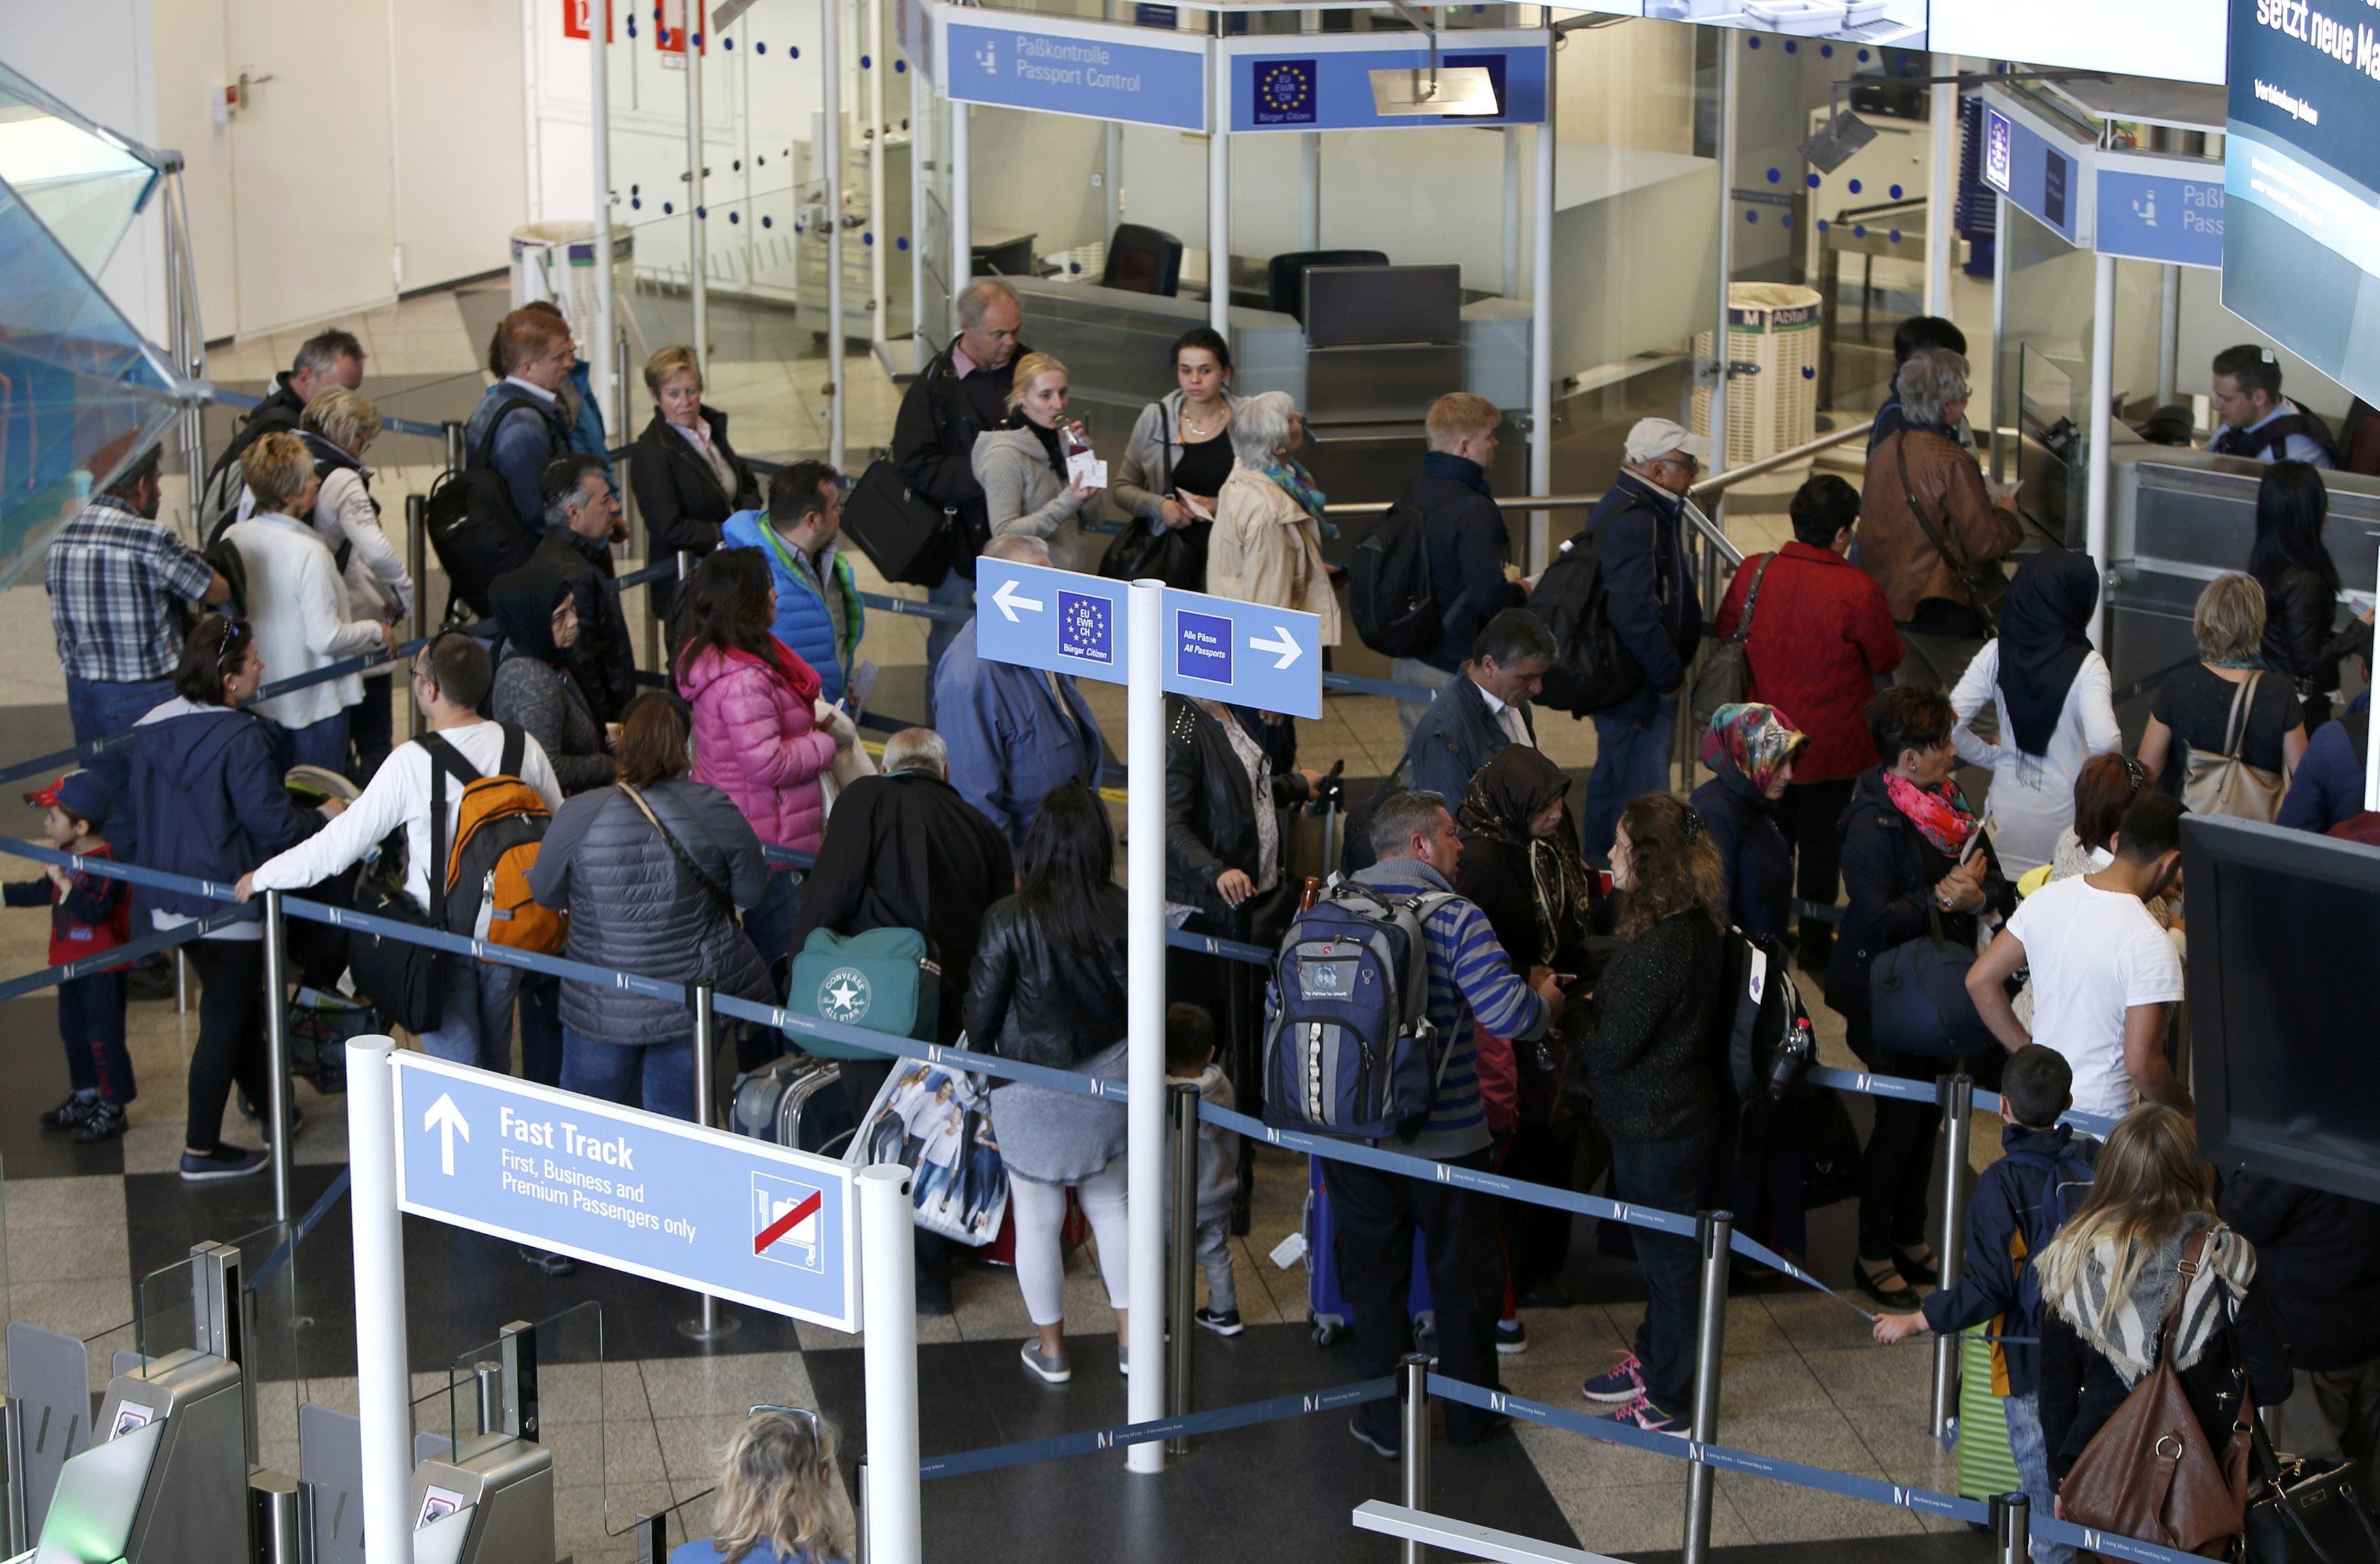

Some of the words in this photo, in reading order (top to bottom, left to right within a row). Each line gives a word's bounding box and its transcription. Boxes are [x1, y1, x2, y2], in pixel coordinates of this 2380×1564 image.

[2311, 12, 2353, 65] neue
[1017, 36, 1110, 65] Paßkontrolle
[1017, 59, 1081, 86] Passport
[1087, 68, 1140, 91] Control
[1076, 617, 1093, 628] EWR
[1080, 609, 1089, 619] EU
[1080, 626, 1090, 636] CH
[1183, 630, 1196, 641] Alle
[1197, 632, 1217, 644] Pässe
[1064, 643, 1085, 656] Bürger
[1086, 647, 1107, 659] Citizen
[1183, 643, 1194, 653] All
[1194, 645, 1226, 659] Passports
[826, 972, 865, 992] CONVERSE
[825, 1006, 838, 1020] ALL
[839, 1008, 860, 1022] STAR
[500, 1106, 554, 1150] Fast
[560, 1122, 635, 1171] Track
[502, 1148, 539, 1178] First,
[544, 1159, 612, 1195] Business
[616, 1184, 645, 1204] and
[503, 1170, 568, 1206] Premium
[573, 1189, 660, 1229] Passengers
[664, 1218, 697, 1244] only
[1894, 1486, 1909, 1507] M
